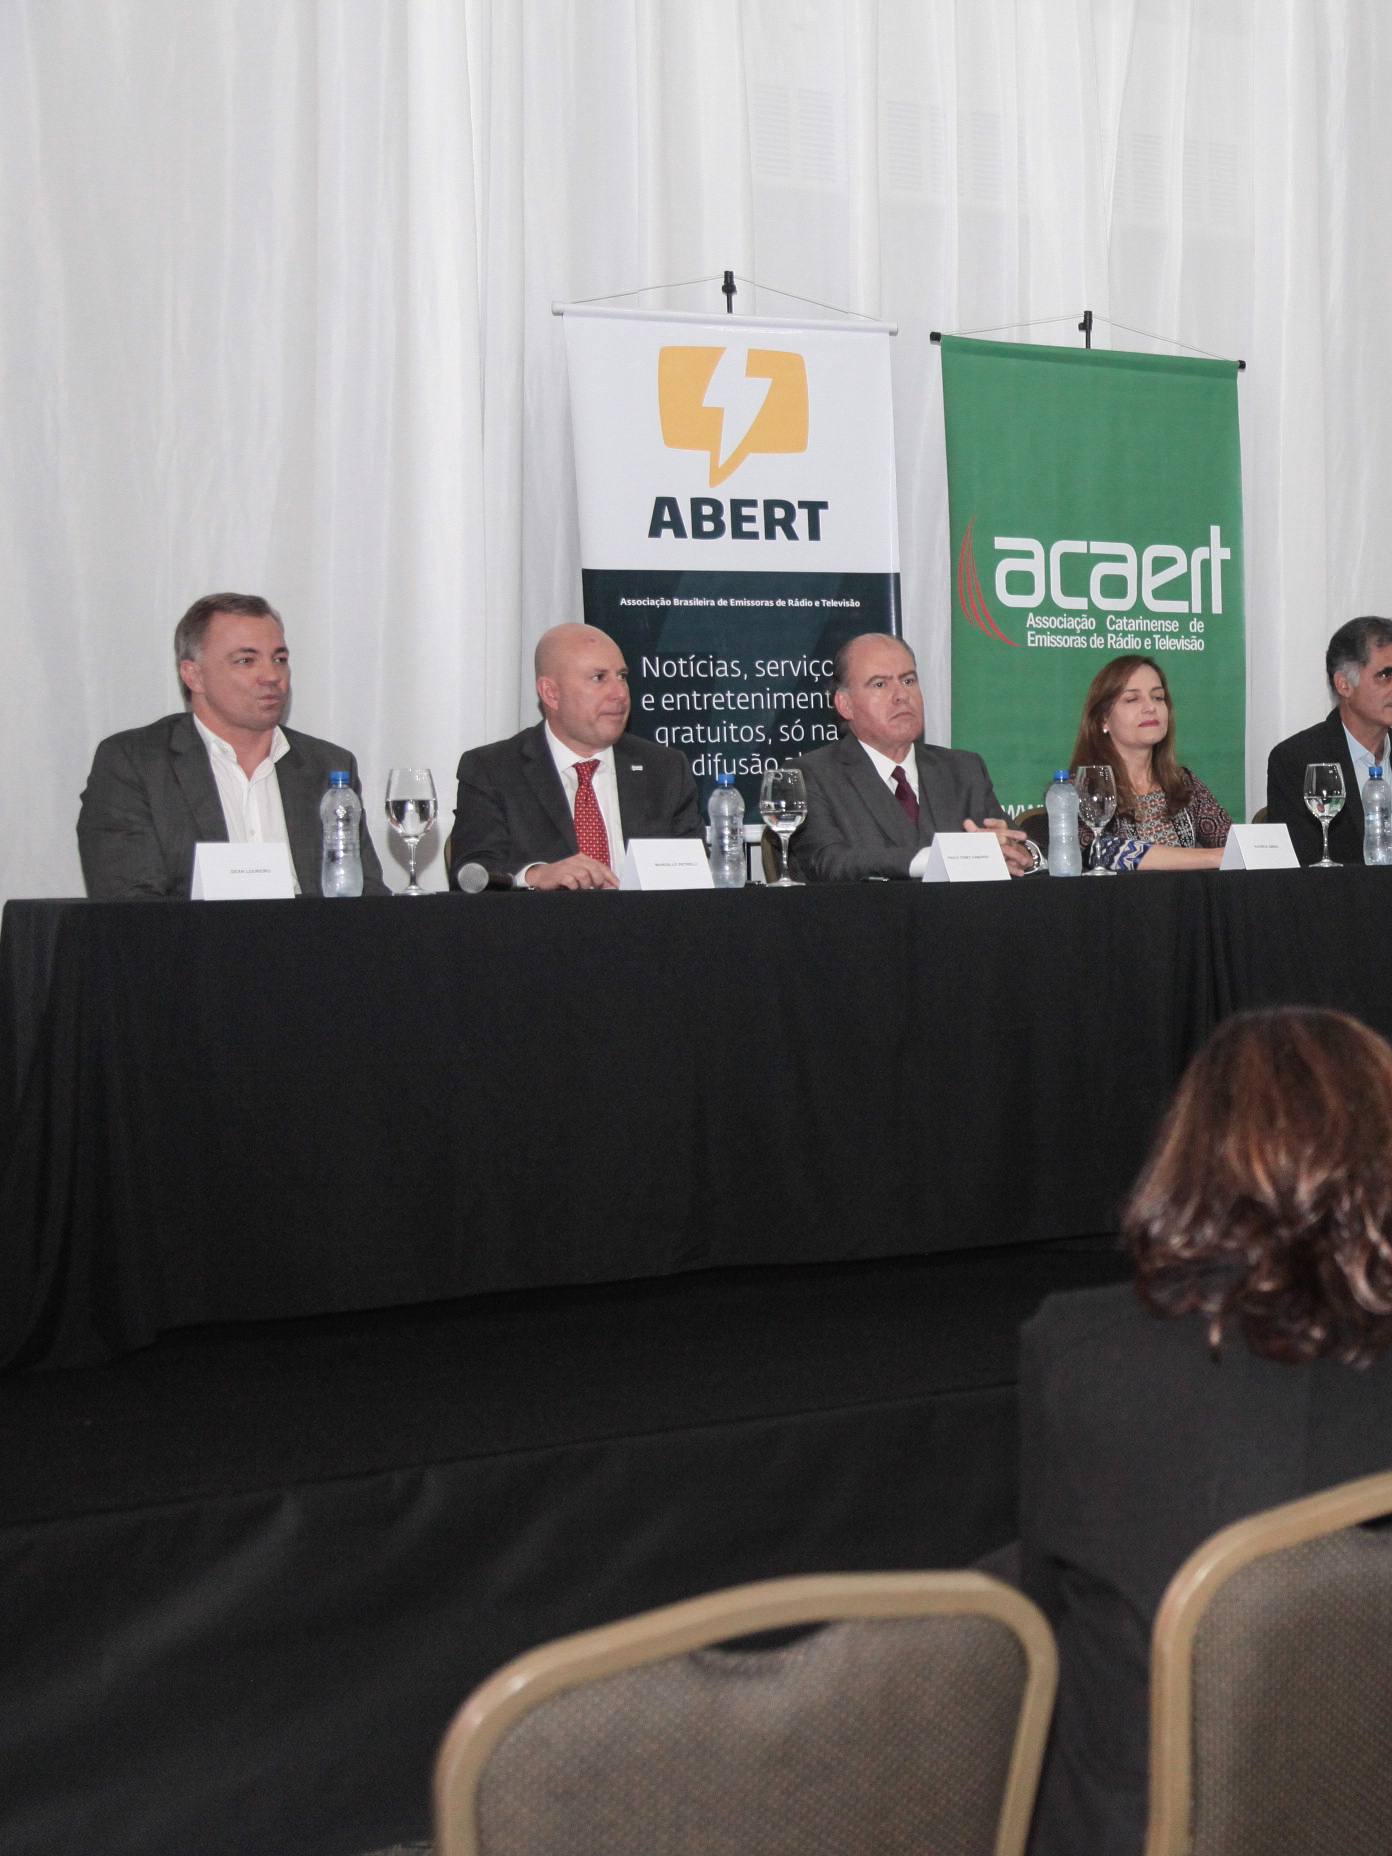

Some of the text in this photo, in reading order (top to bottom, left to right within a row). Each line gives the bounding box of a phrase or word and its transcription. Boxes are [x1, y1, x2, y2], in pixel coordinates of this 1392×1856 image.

[648, 496, 829, 541] ABERT
[994, 525, 1231, 614] acaert
[620, 597, 672, 608] Associação
[673, 597, 716, 607] Brasileira
[717, 598, 728, 607] de
[730, 598, 774, 607] Emissoras
[776, 598, 786, 607] de
[788, 598, 813, 607] Rádio
[821, 599, 861, 608] Televisão
[1026, 612, 1205, 633] Associação Catarinense de
[1027, 631, 1205, 651] Emissoras de Rádio e Televisão
[642, 654, 834, 682] Notícias, serviço
[642, 687, 835, 711] e entreteniment
[779, 719, 804, 742] só
[811, 724, 839, 741] na
[692, 752, 779, 781] difusão
